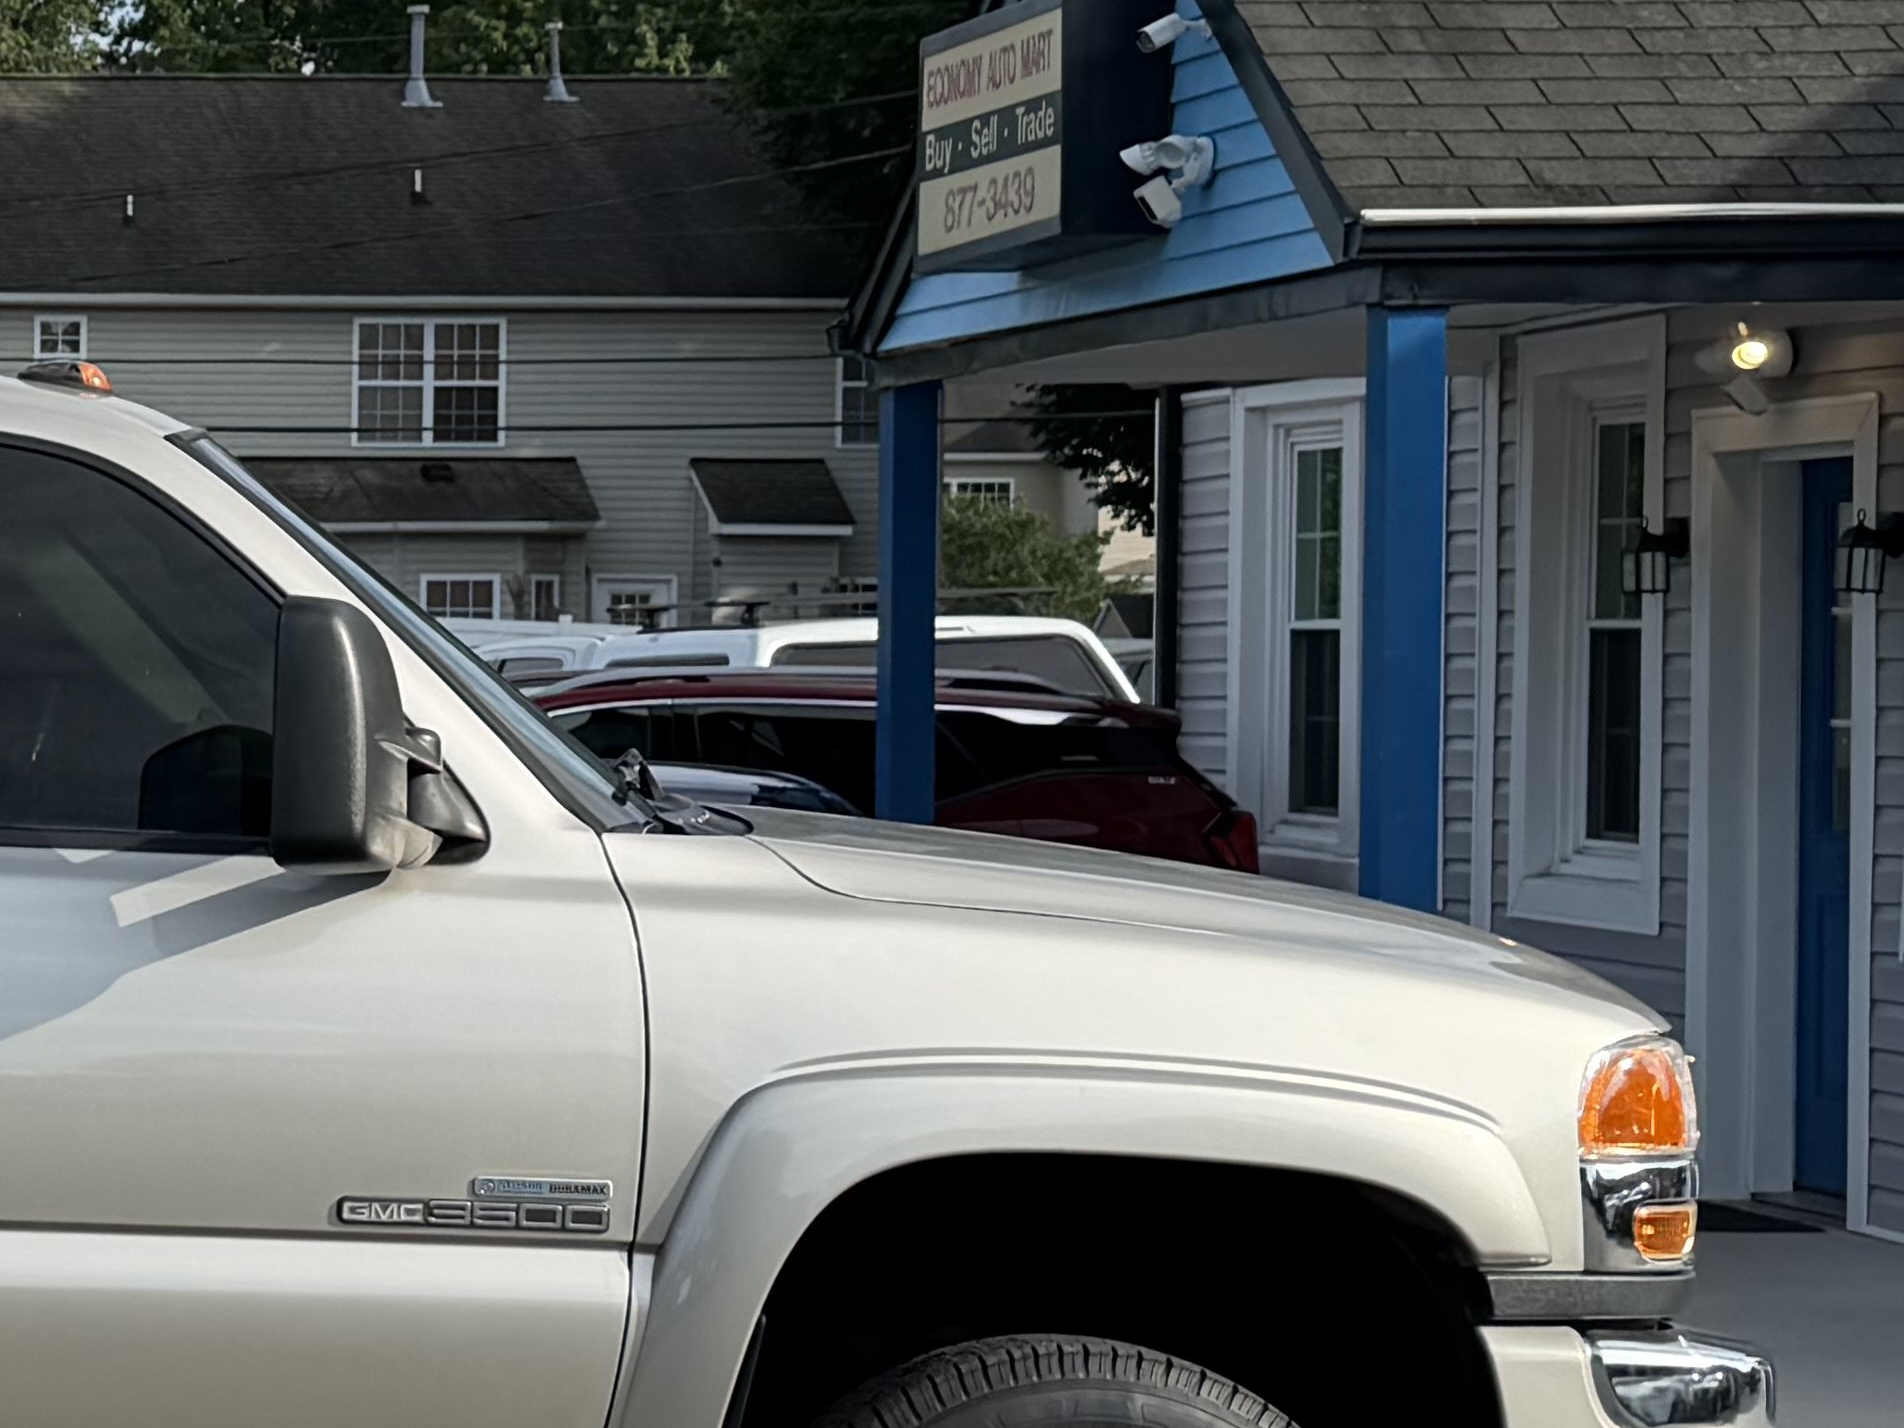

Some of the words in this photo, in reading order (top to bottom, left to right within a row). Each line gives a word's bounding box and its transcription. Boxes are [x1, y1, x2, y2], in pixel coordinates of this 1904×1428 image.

[927, 54, 982, 108] ECONOMY
[986, 43, 1017, 91] AUTO
[1020, 29, 1053, 79] MART
[925, 134, 952, 174] Buy
[971, 114, 998, 159] Sell
[1016, 100, 1055, 145] Trade
[944, 166, 1036, 233] 877-3439
[342, 1201, 425, 1223] GMC
[426, 1199, 611, 1232] 3500
[549, 1183, 607, 1196] DURAMAX
